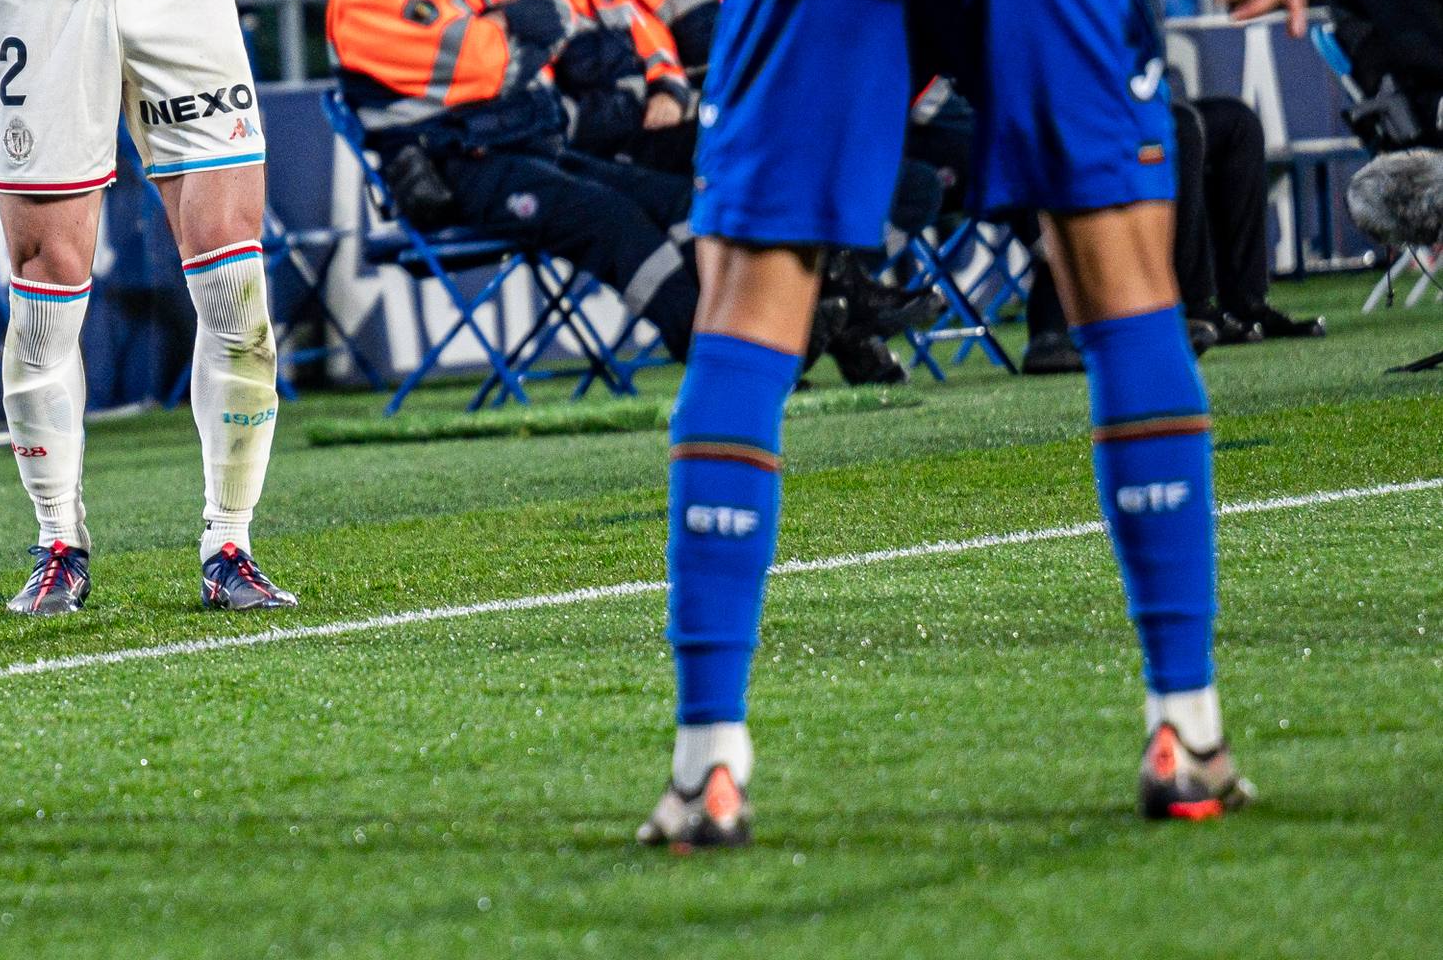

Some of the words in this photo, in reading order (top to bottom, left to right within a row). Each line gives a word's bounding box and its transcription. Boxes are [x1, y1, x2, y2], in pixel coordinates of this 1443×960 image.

[0, 36, 27, 106] 2
[139, 84, 253, 125] INEXO
[222, 407, 275, 426] 1928
[11, 442, 47, 458] 28
